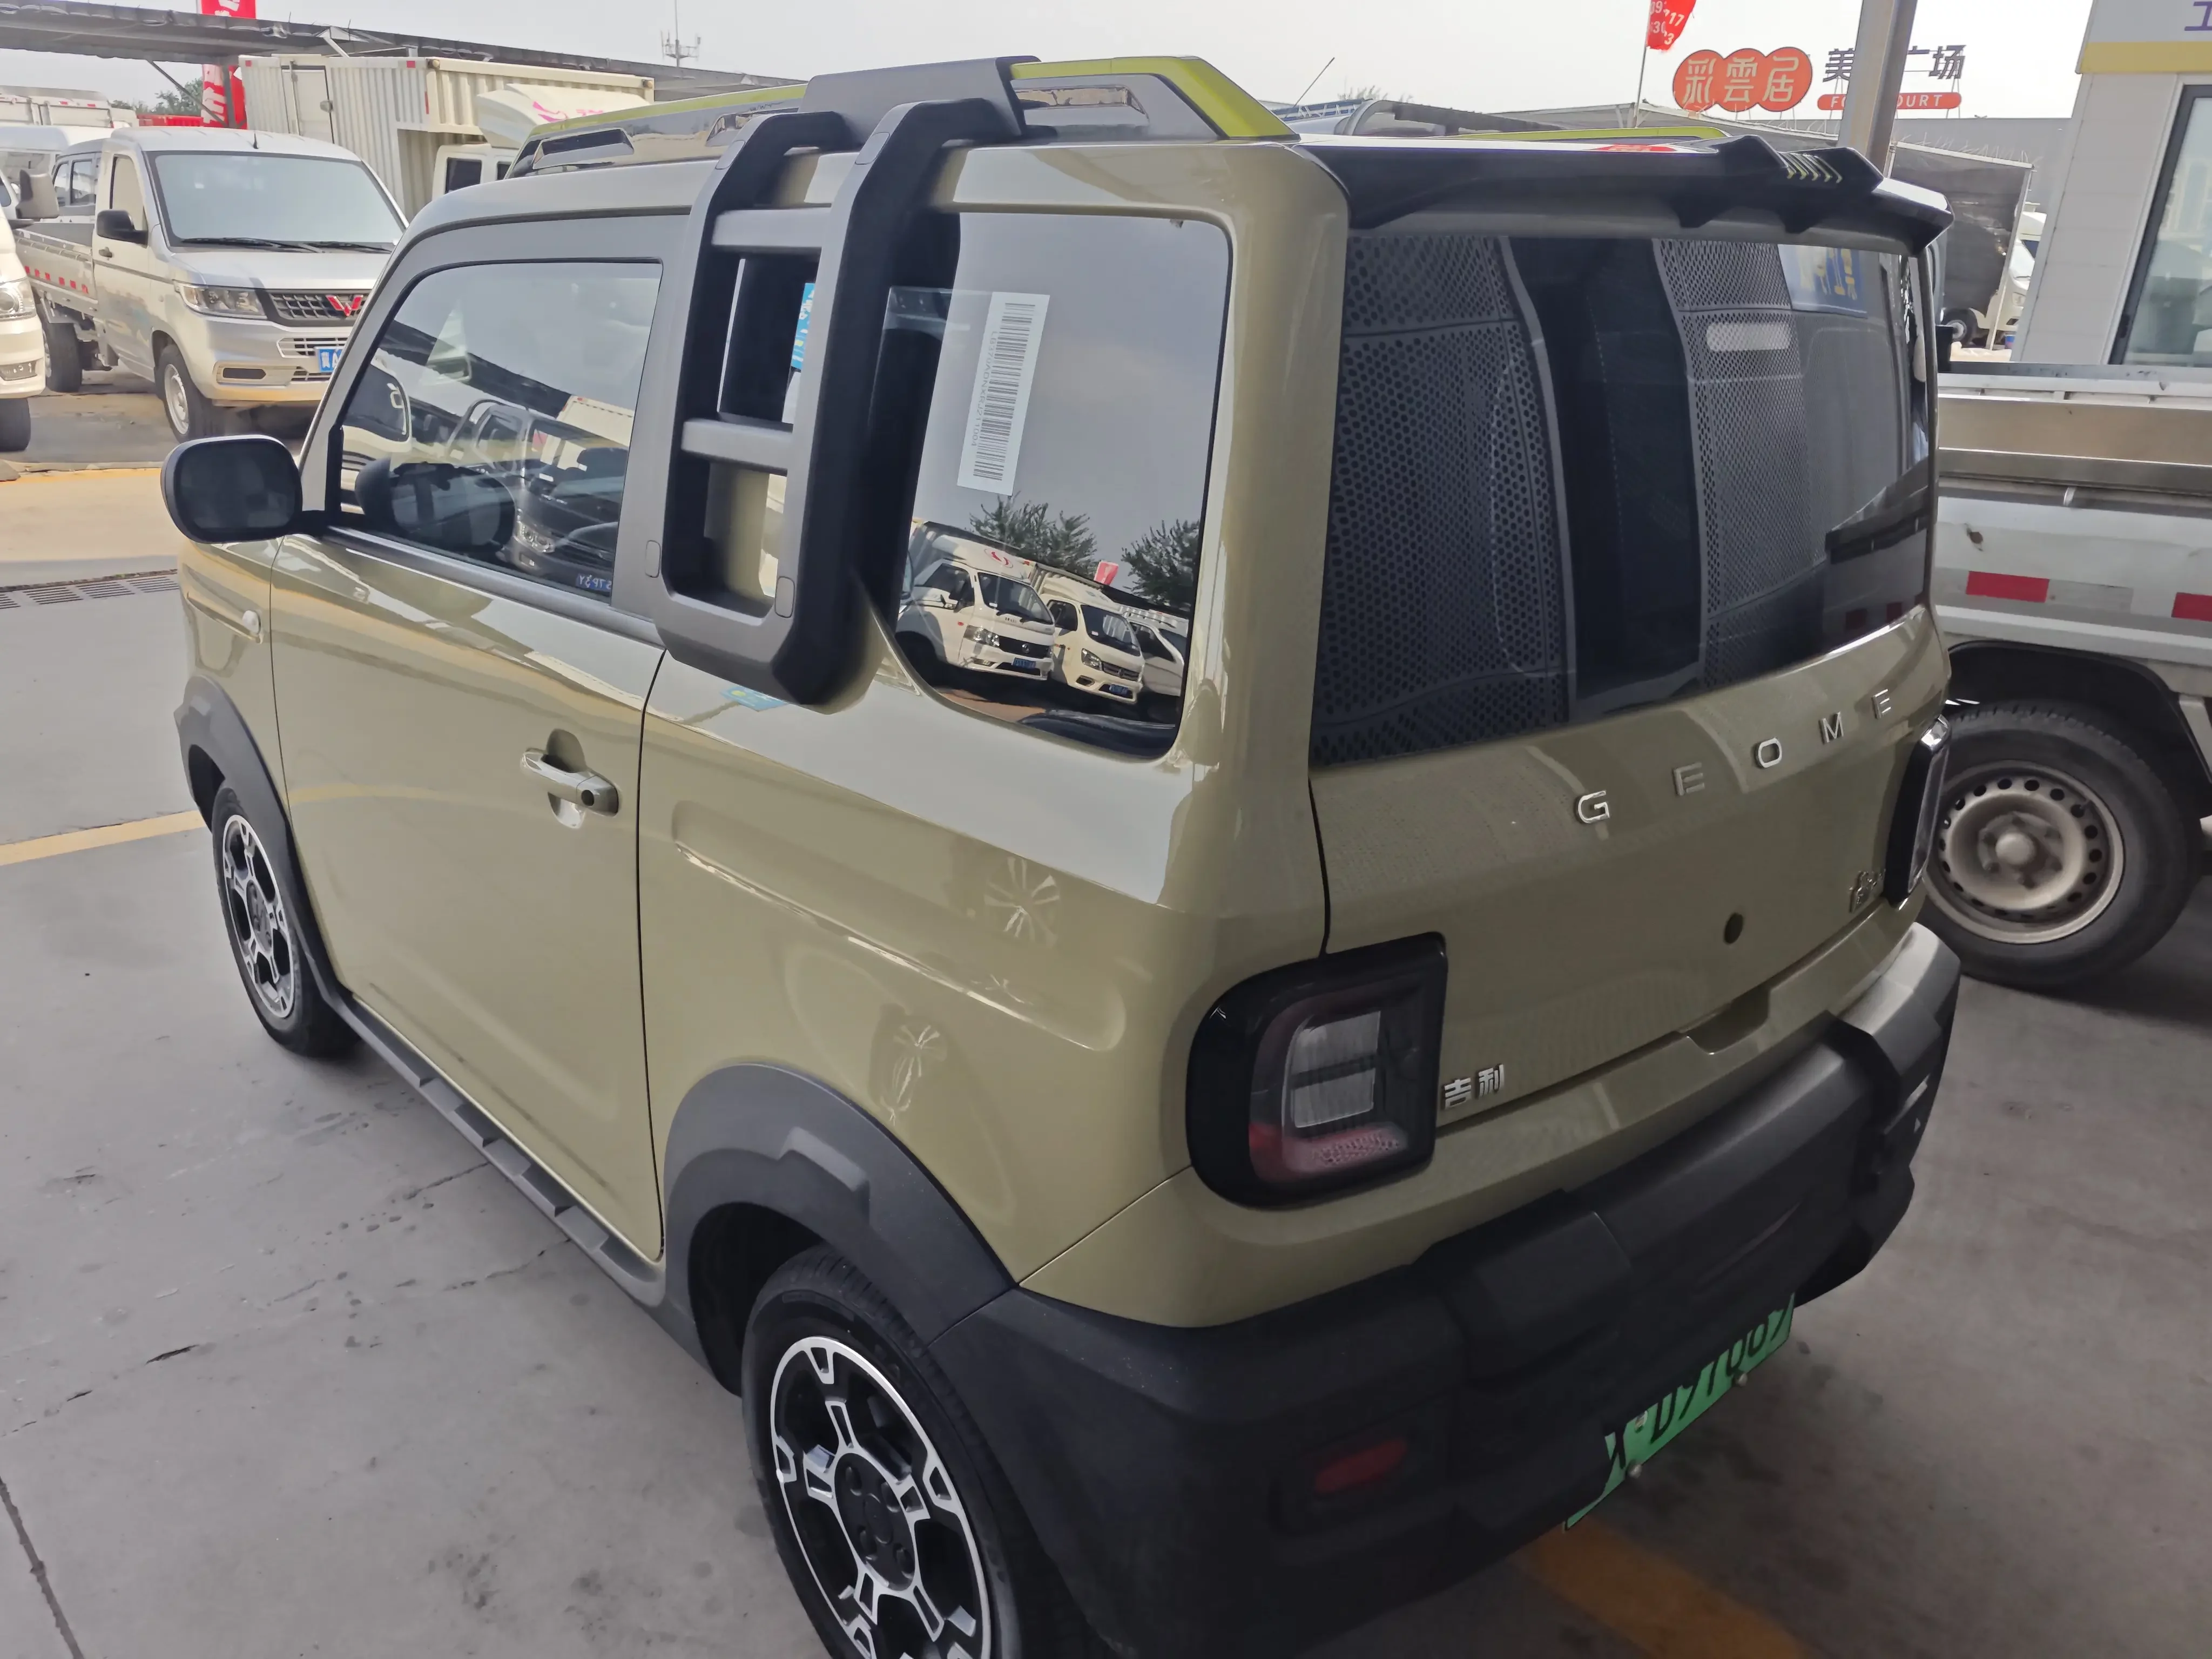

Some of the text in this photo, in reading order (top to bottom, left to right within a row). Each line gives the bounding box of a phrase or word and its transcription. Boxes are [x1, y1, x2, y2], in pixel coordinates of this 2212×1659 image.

[1682, 55, 1799, 104] 彩雲居
[1444, 1064, 1505, 1110] 吉利
